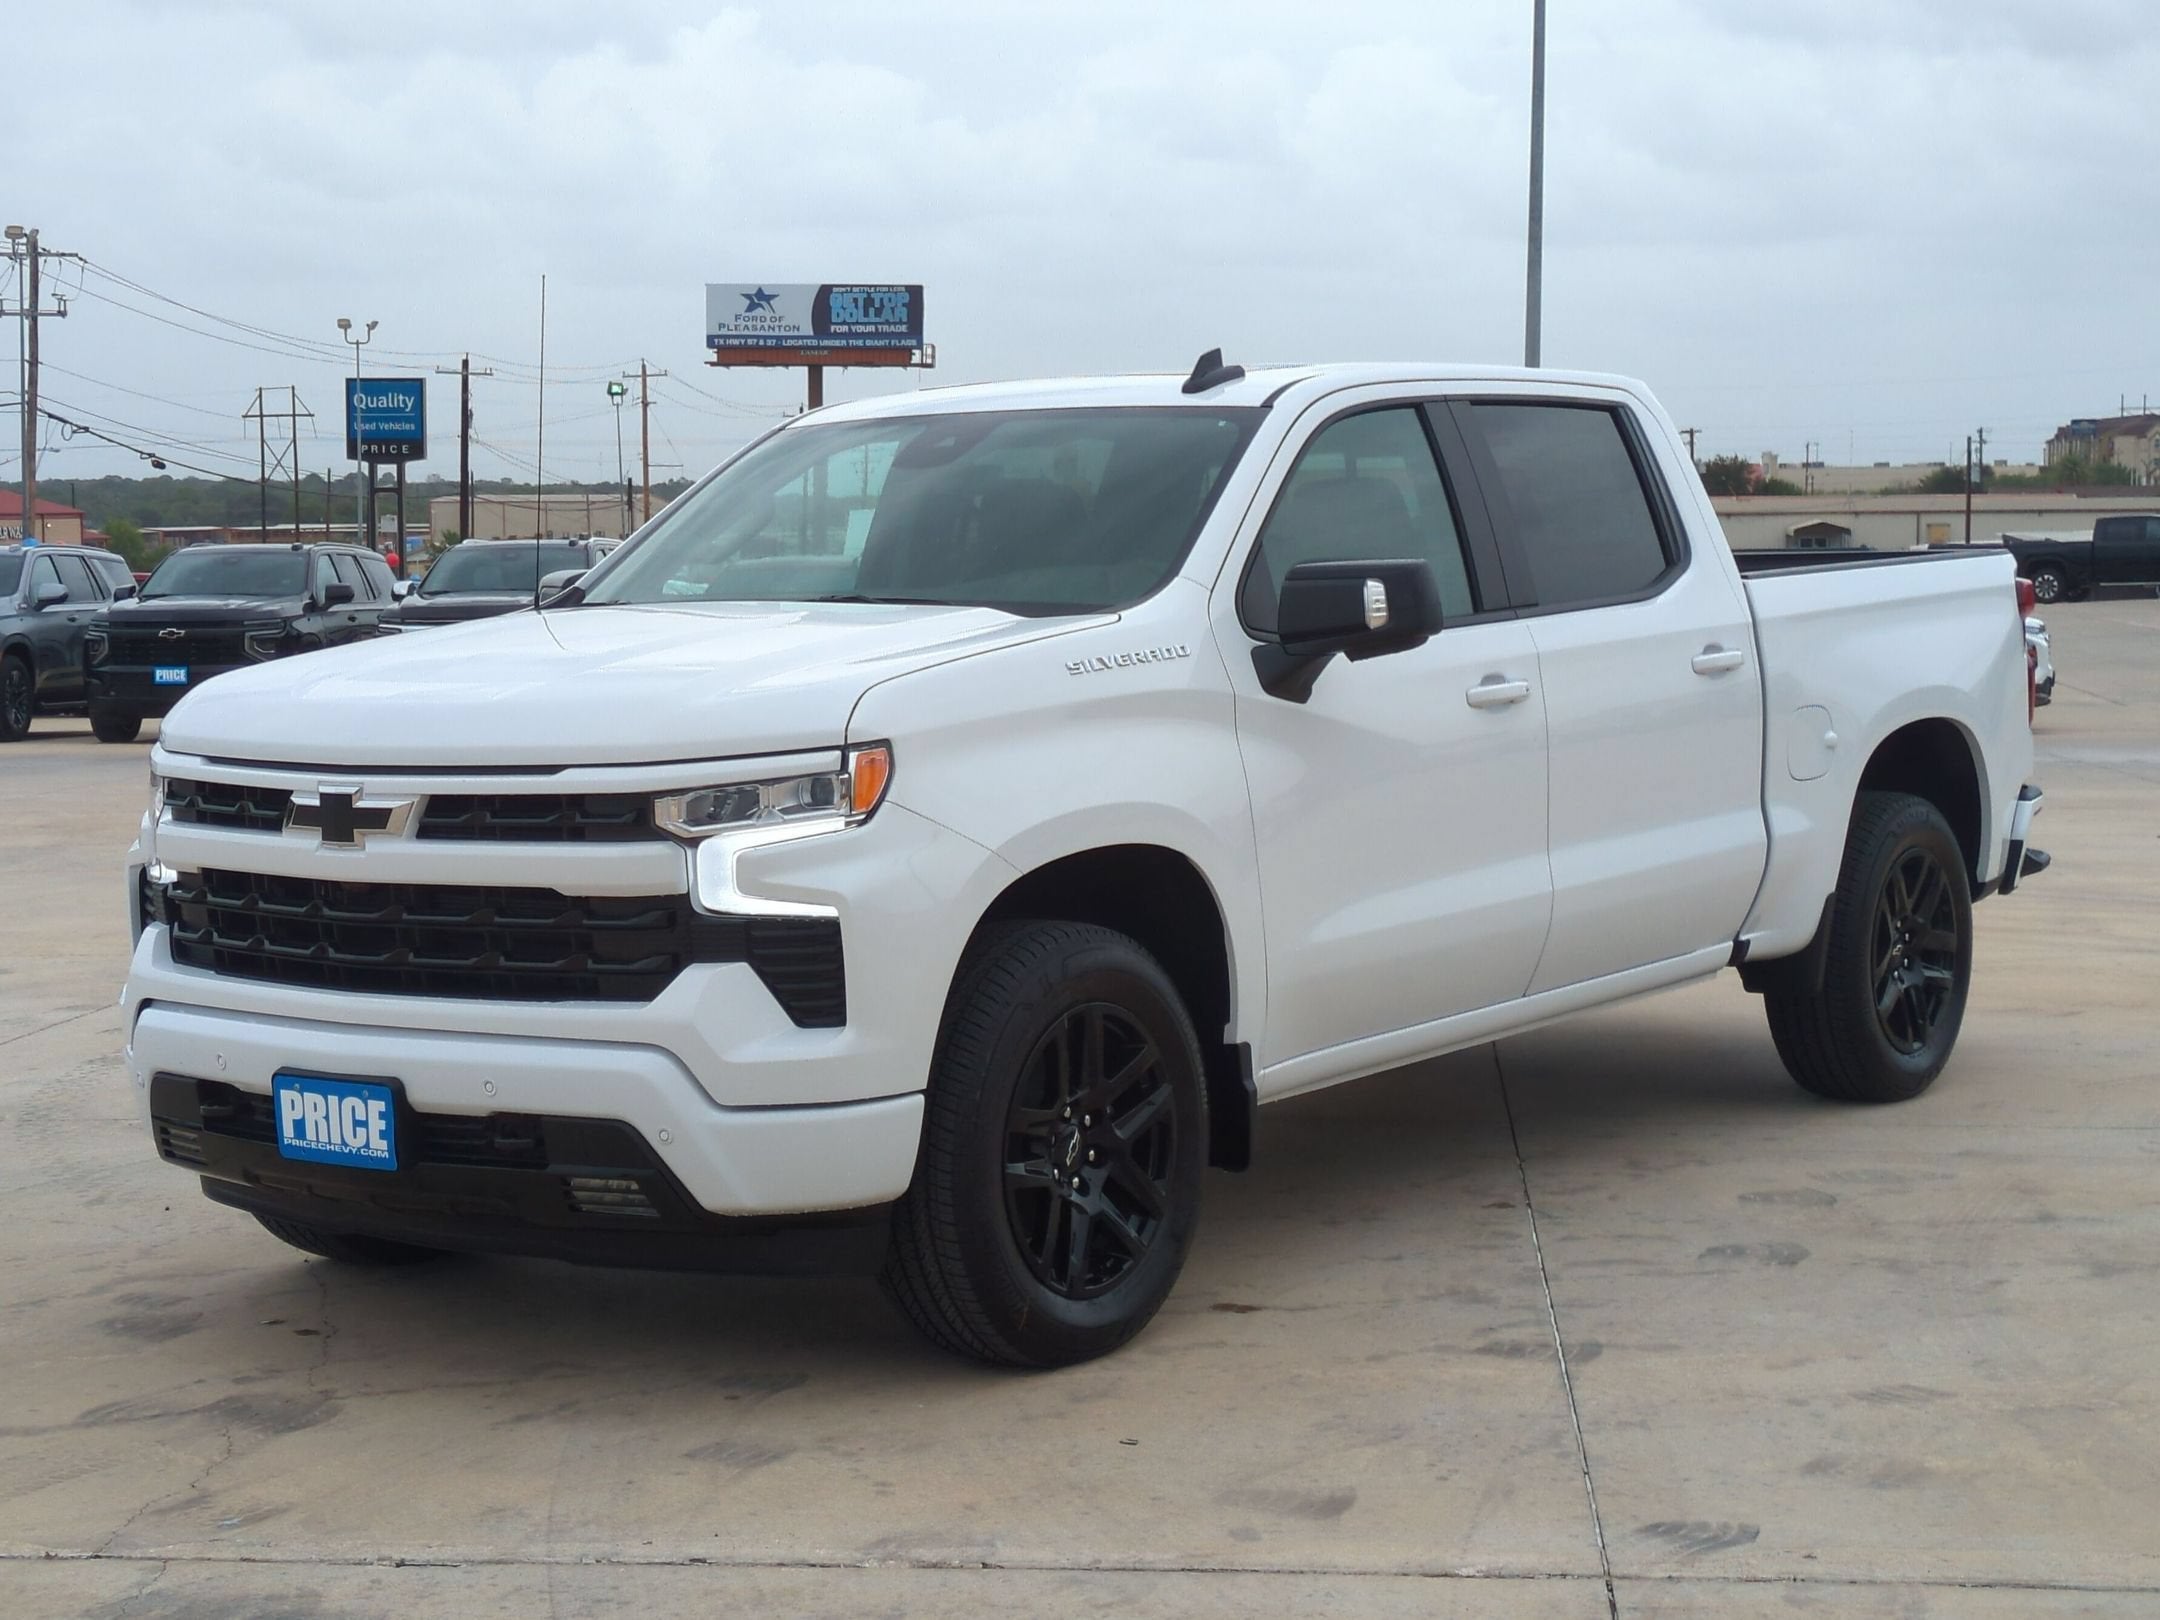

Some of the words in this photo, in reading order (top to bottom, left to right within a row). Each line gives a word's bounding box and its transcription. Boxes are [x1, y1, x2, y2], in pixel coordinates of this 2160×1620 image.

[830, 292, 866, 308] GET
[872, 292, 910, 308] TOP
[736, 314, 766, 322] FORD
[831, 306, 908, 322] DOLLAR
[718, 322, 800, 332] PLEASANTON
[877, 324, 908, 332] TRADE
[354, 392, 414, 412] Quality
[354, 422, 376, 430] Used
[378, 422, 416, 430] Vehicles
[361, 444, 408, 454] PRICE
[1065, 644, 1191, 676] SILVERADO
[156, 670, 186, 680] PRICE
[280, 1090, 388, 1150] PRICE
[284, 1138, 388, 1158] PRICECHEVY.COM
